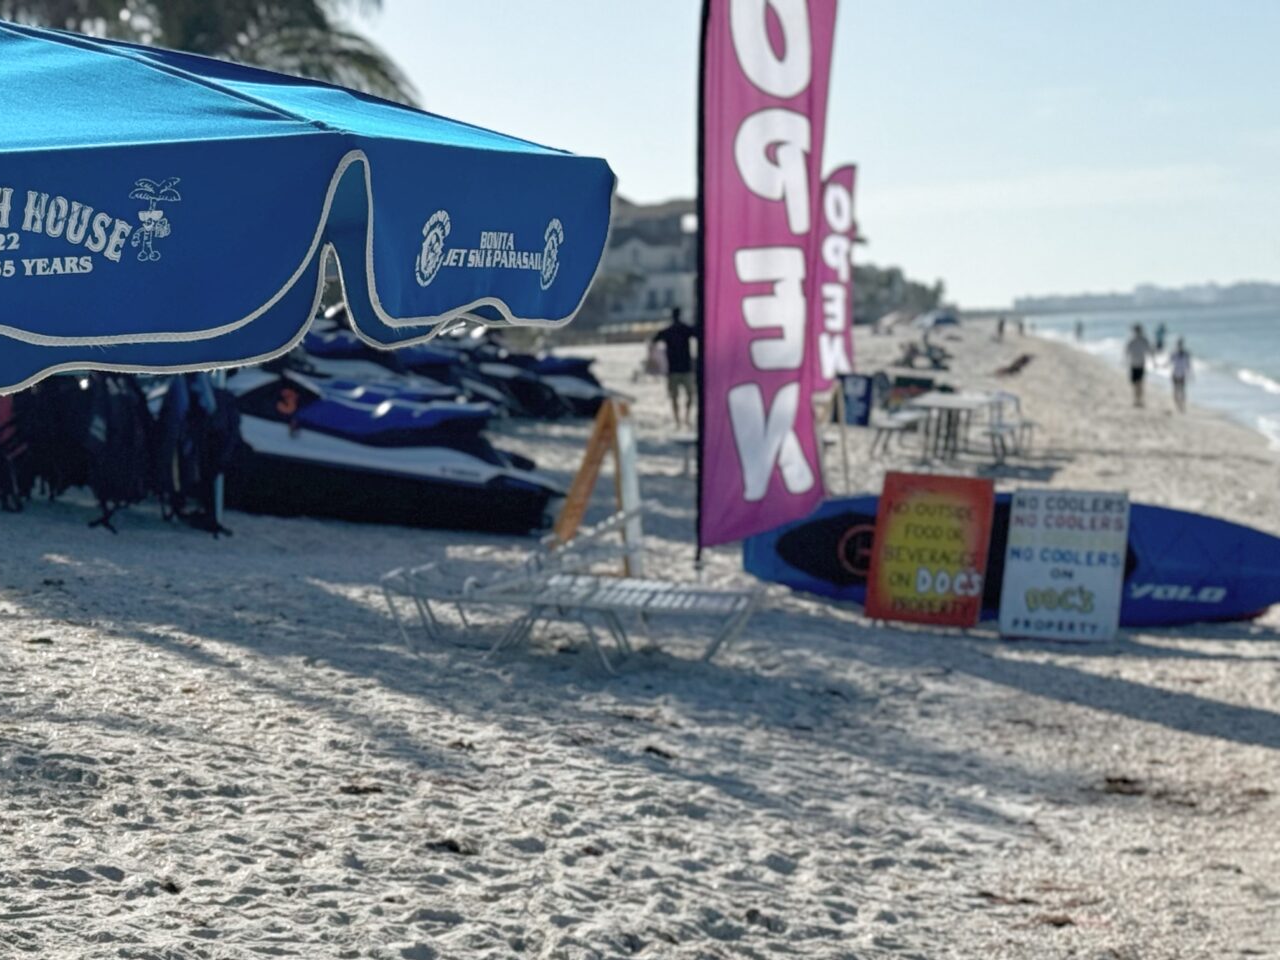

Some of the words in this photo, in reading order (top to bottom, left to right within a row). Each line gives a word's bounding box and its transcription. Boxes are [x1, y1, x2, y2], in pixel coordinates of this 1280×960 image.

[21, 189, 133, 264] HOUSE
[480, 231, 515, 251] BONITA
[21, 255, 94, 276] YEARS
[442, 248, 467, 267] JET
[467, 249, 485, 268] SKI
[493, 250, 542, 271] PARASAIL
[1016, 496, 1039, 510] NO
[1045, 496, 1125, 513] COOLERS
[904, 523, 944, 539] FOOD
[1014, 513, 1038, 528] NO
[1043, 514, 1124, 531] COOLERS
[1010, 547, 1034, 561] NO
[1039, 547, 1121, 568] COOLERS
[889, 571, 911, 588] ON
[1050, 567, 1074, 579] ON
[1131, 582, 1227, 603] YOLO
[1012, 617, 1098, 635] PROPERTY
